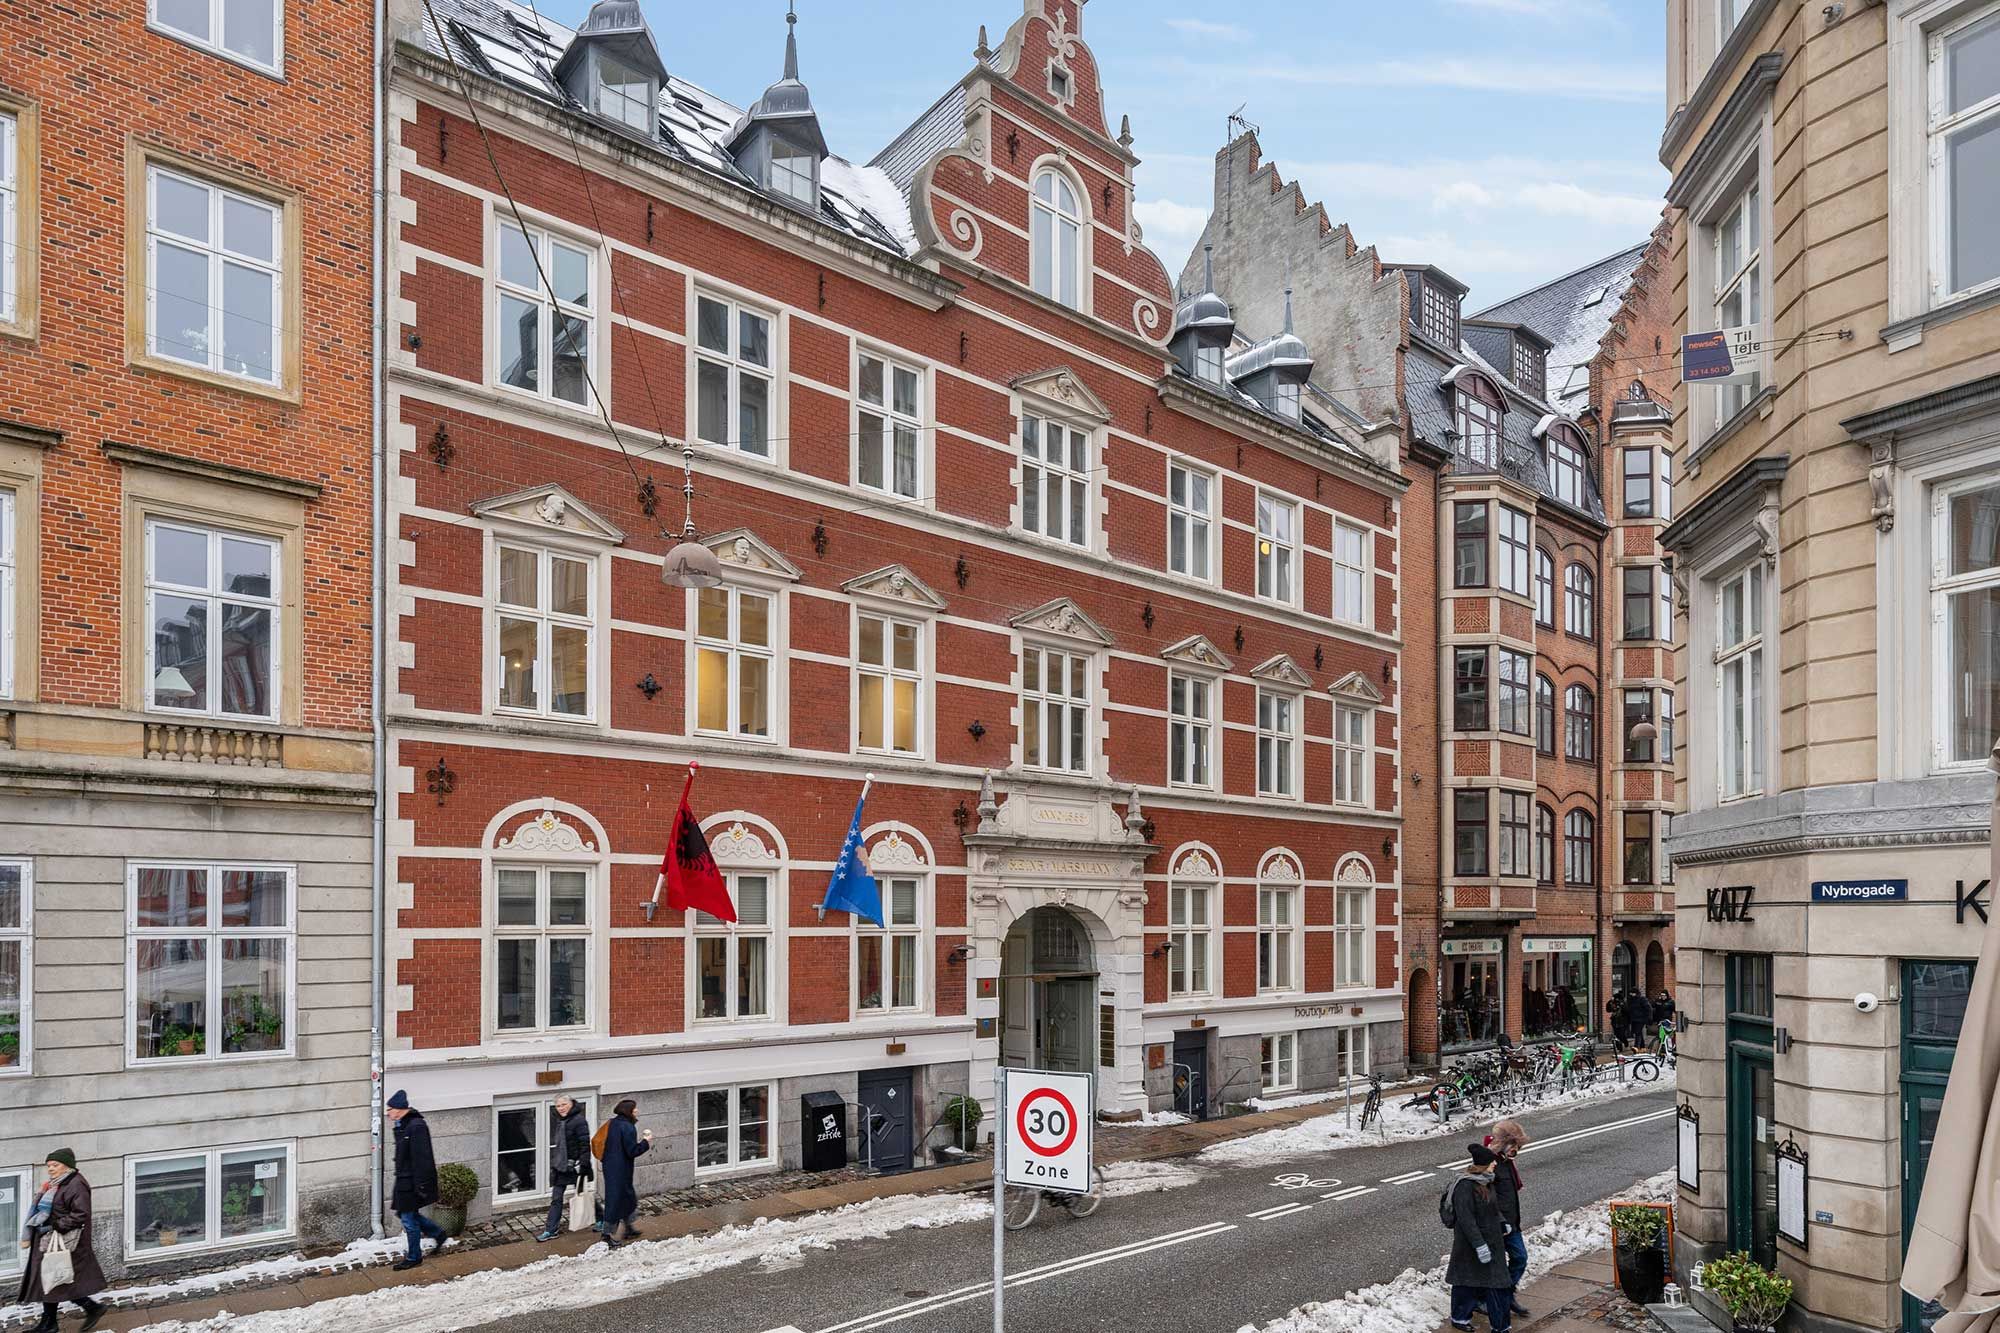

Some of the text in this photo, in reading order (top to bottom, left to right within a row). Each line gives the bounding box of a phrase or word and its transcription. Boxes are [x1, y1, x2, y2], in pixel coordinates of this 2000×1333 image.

[1734, 330, 1752, 343] Til
[1688, 340, 1719, 351] newsec
[1735, 342, 1761, 355] leje
[1822, 884, 1895, 898] Nybrogade
[1707, 886, 1753, 922] KATZ
[1029, 1109, 1066, 1136] 30
[1025, 1160, 1068, 1179] Zone
